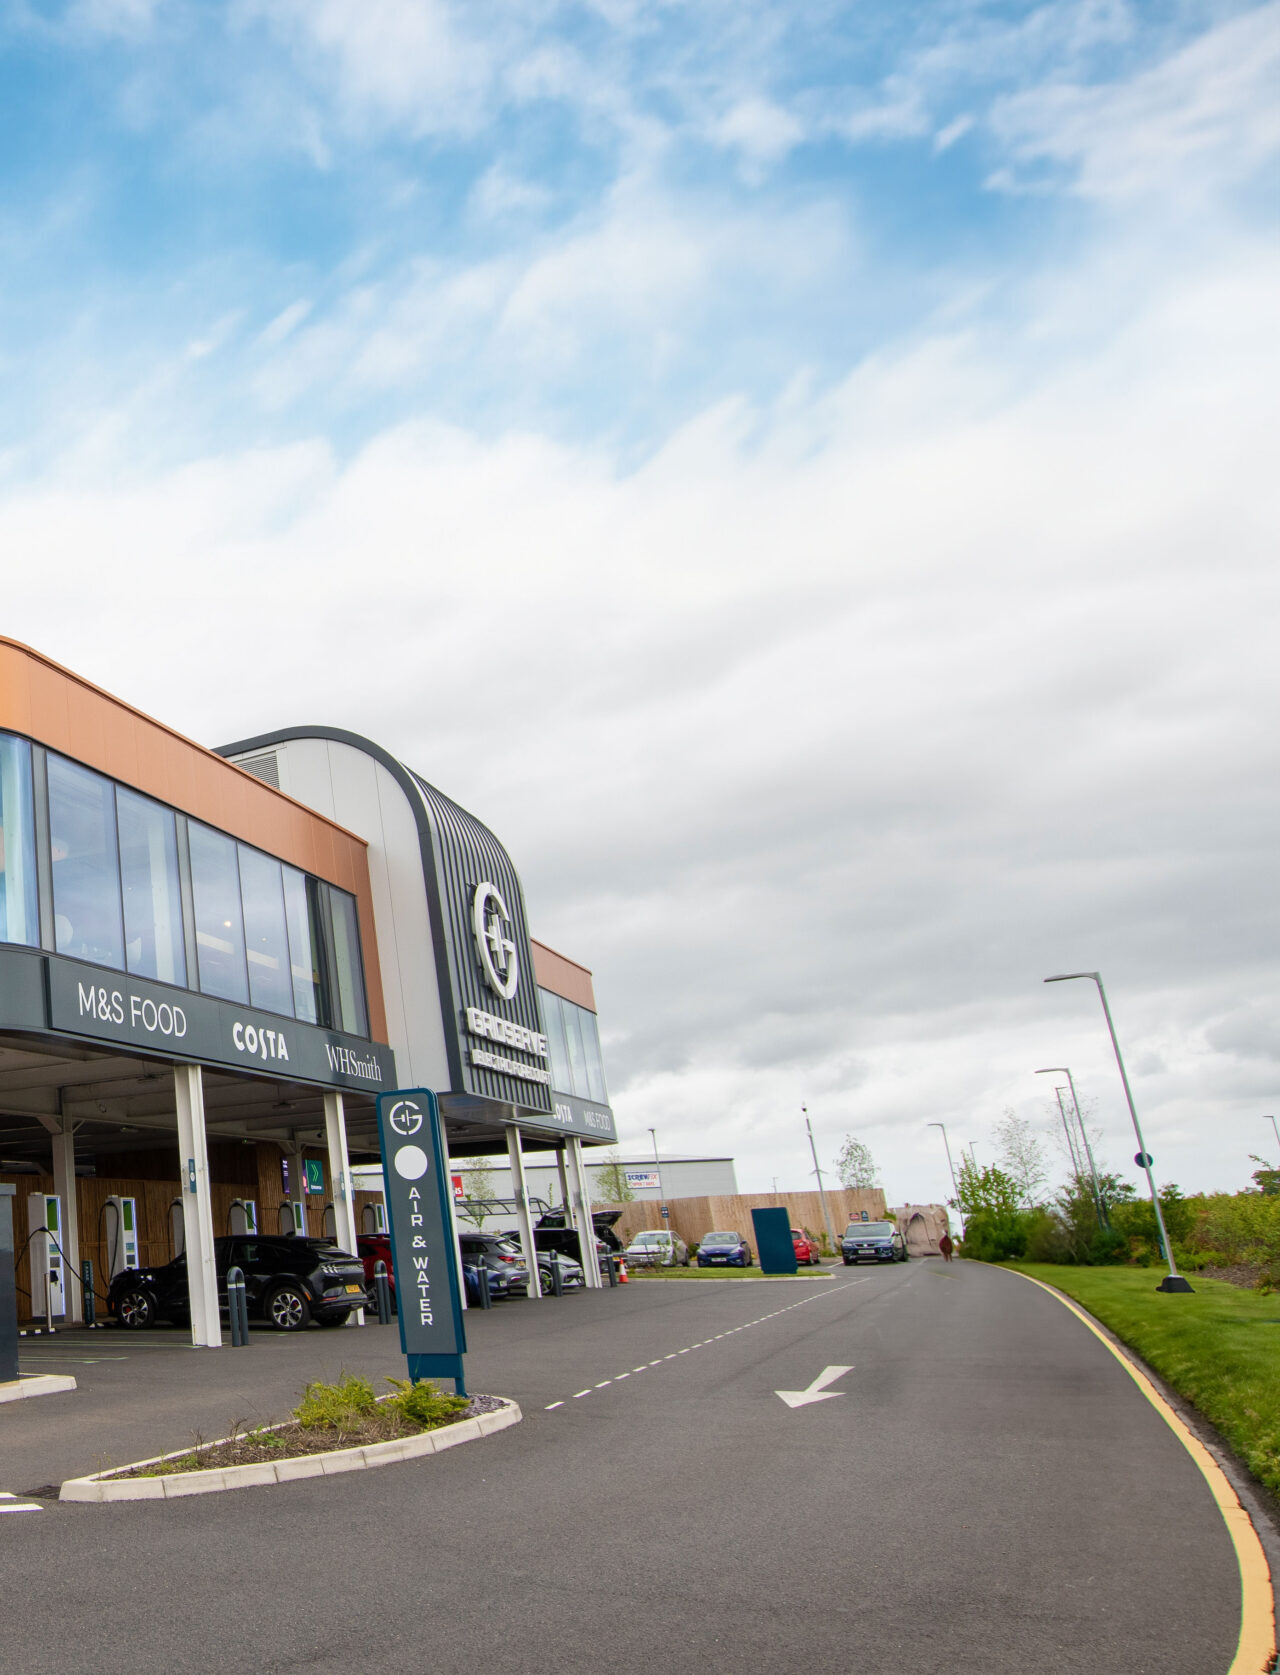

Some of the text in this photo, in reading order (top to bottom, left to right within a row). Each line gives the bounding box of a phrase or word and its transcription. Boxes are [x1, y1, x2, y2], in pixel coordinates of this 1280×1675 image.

[77, 982, 187, 1037] M&S FOOD
[232, 1022, 289, 1061] COSTA
[466, 1007, 548, 1057] GRIDSERVE
[324, 1043, 383, 1082] WHSmith
[553, 1103, 573, 1124] OSTA
[408, 1187, 433, 1326] AIR & WATER
